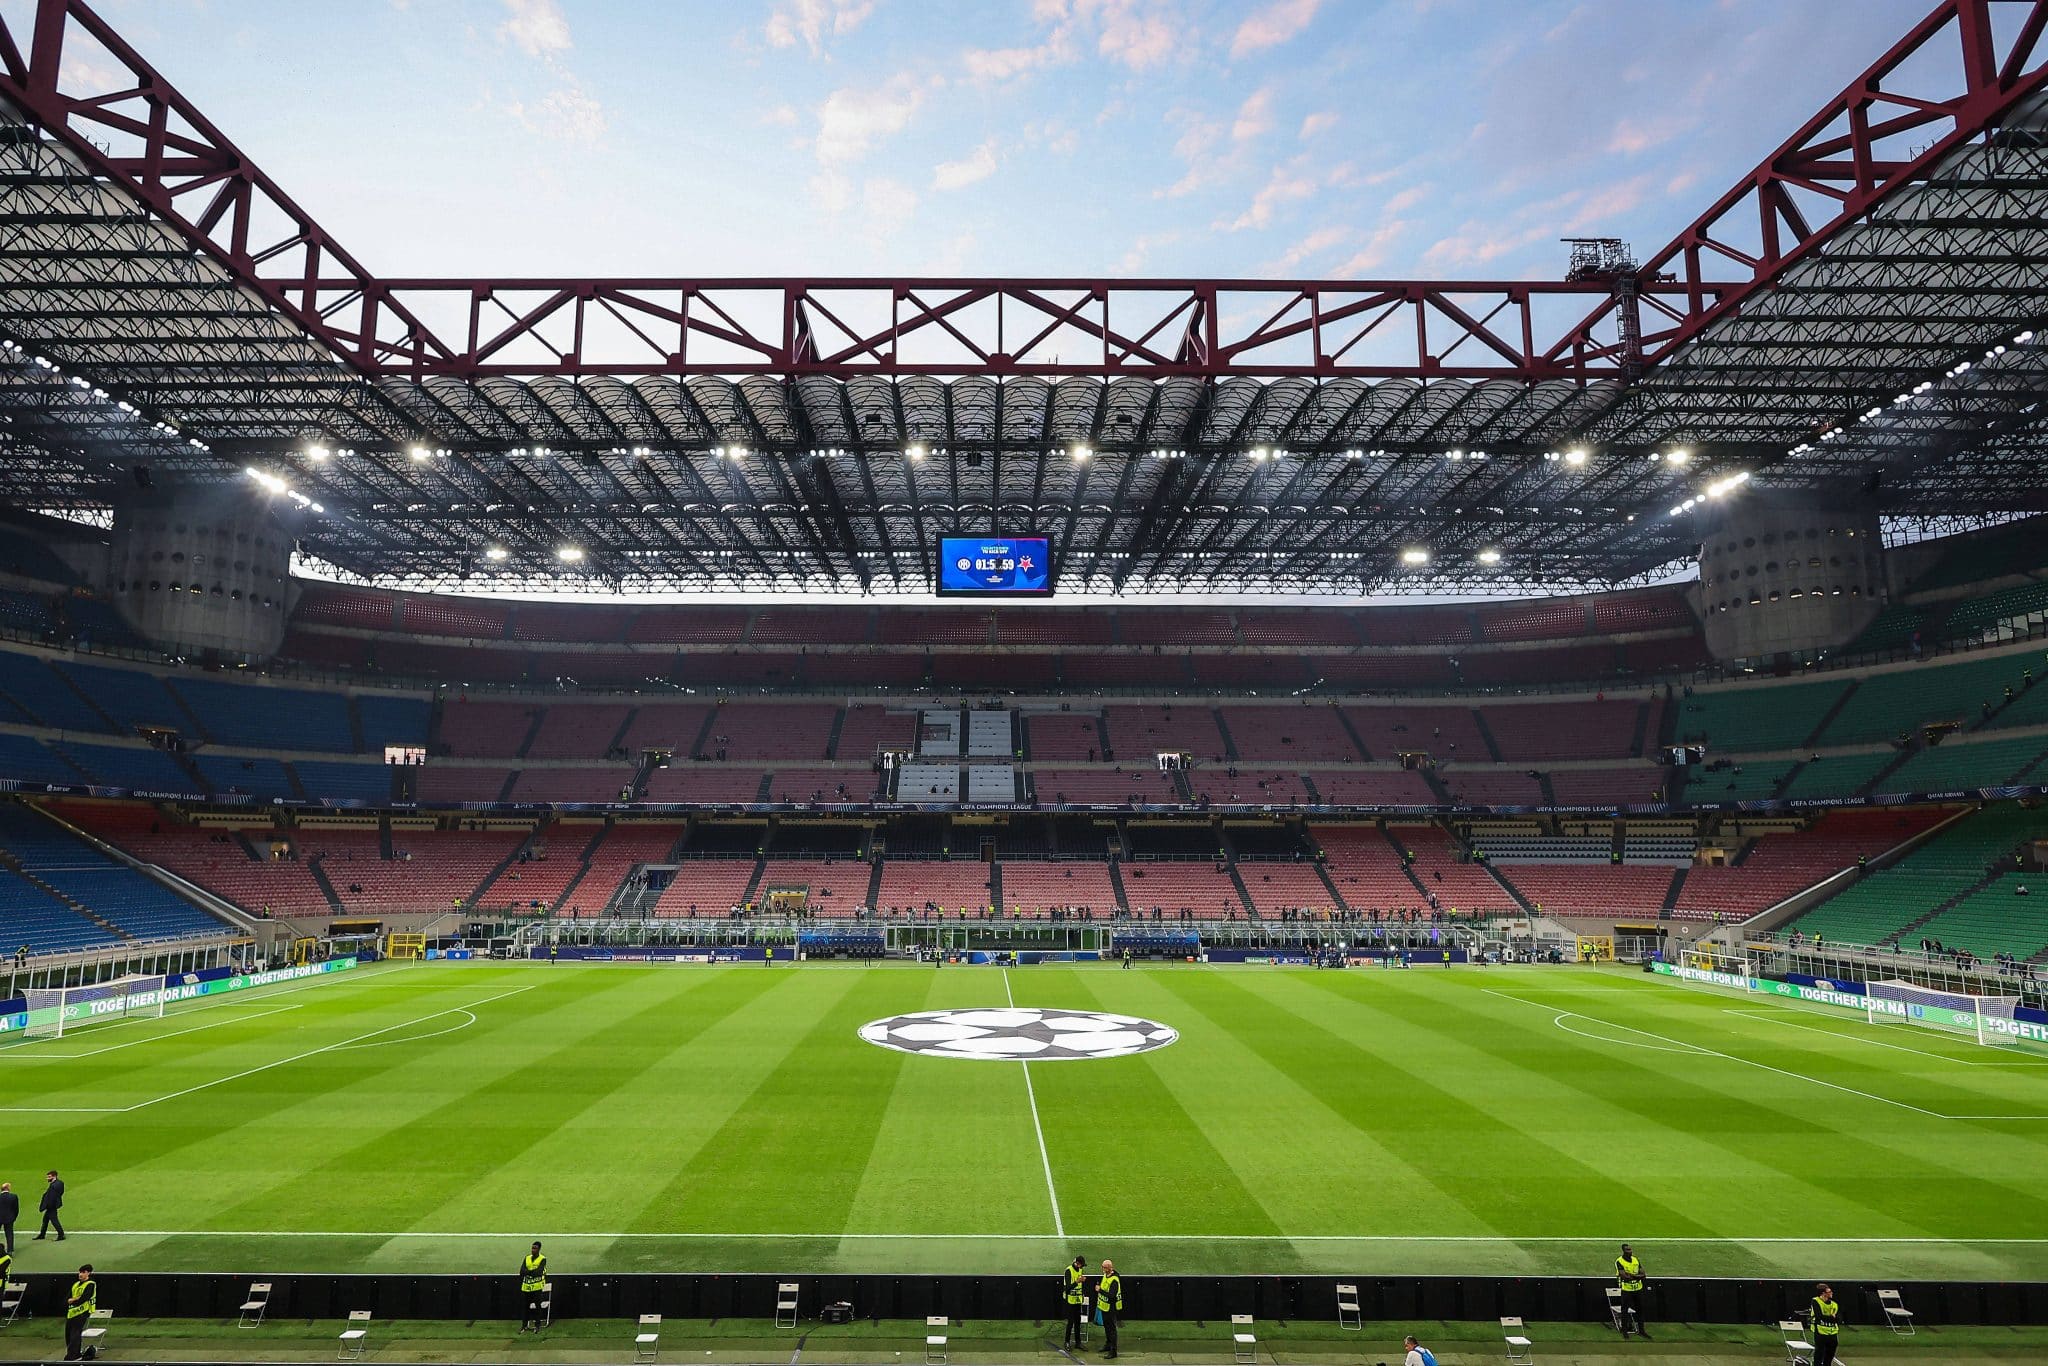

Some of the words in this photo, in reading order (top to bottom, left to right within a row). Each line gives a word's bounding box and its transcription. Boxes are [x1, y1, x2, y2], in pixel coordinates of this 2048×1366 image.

[133, 791, 149, 799] UEFA
[150, 792, 182, 800] CHAMPIONS
[183, 793, 206, 801] LEAGUE
[1844, 797, 1865, 805] LEAGUE
[249, 968, 294, 983] TOGETHER
[294, 966, 311, 977] FOR
[1669, 966, 1713, 981] TOGETHER
[1713, 972, 1731, 984] FOR
[229, 978, 243, 989] UEFA
[1776, 983, 1791, 994] UEFA
[89, 990, 156, 1015] TOGETHER
[157, 988, 180, 1003] FOR
[1798, 987, 1859, 1008] TOGETHER
[1860, 998, 1886, 1012] FOR
[64, 1006, 79, 1017] UEFA
[1952, 1013, 1973, 1026] UEFA
